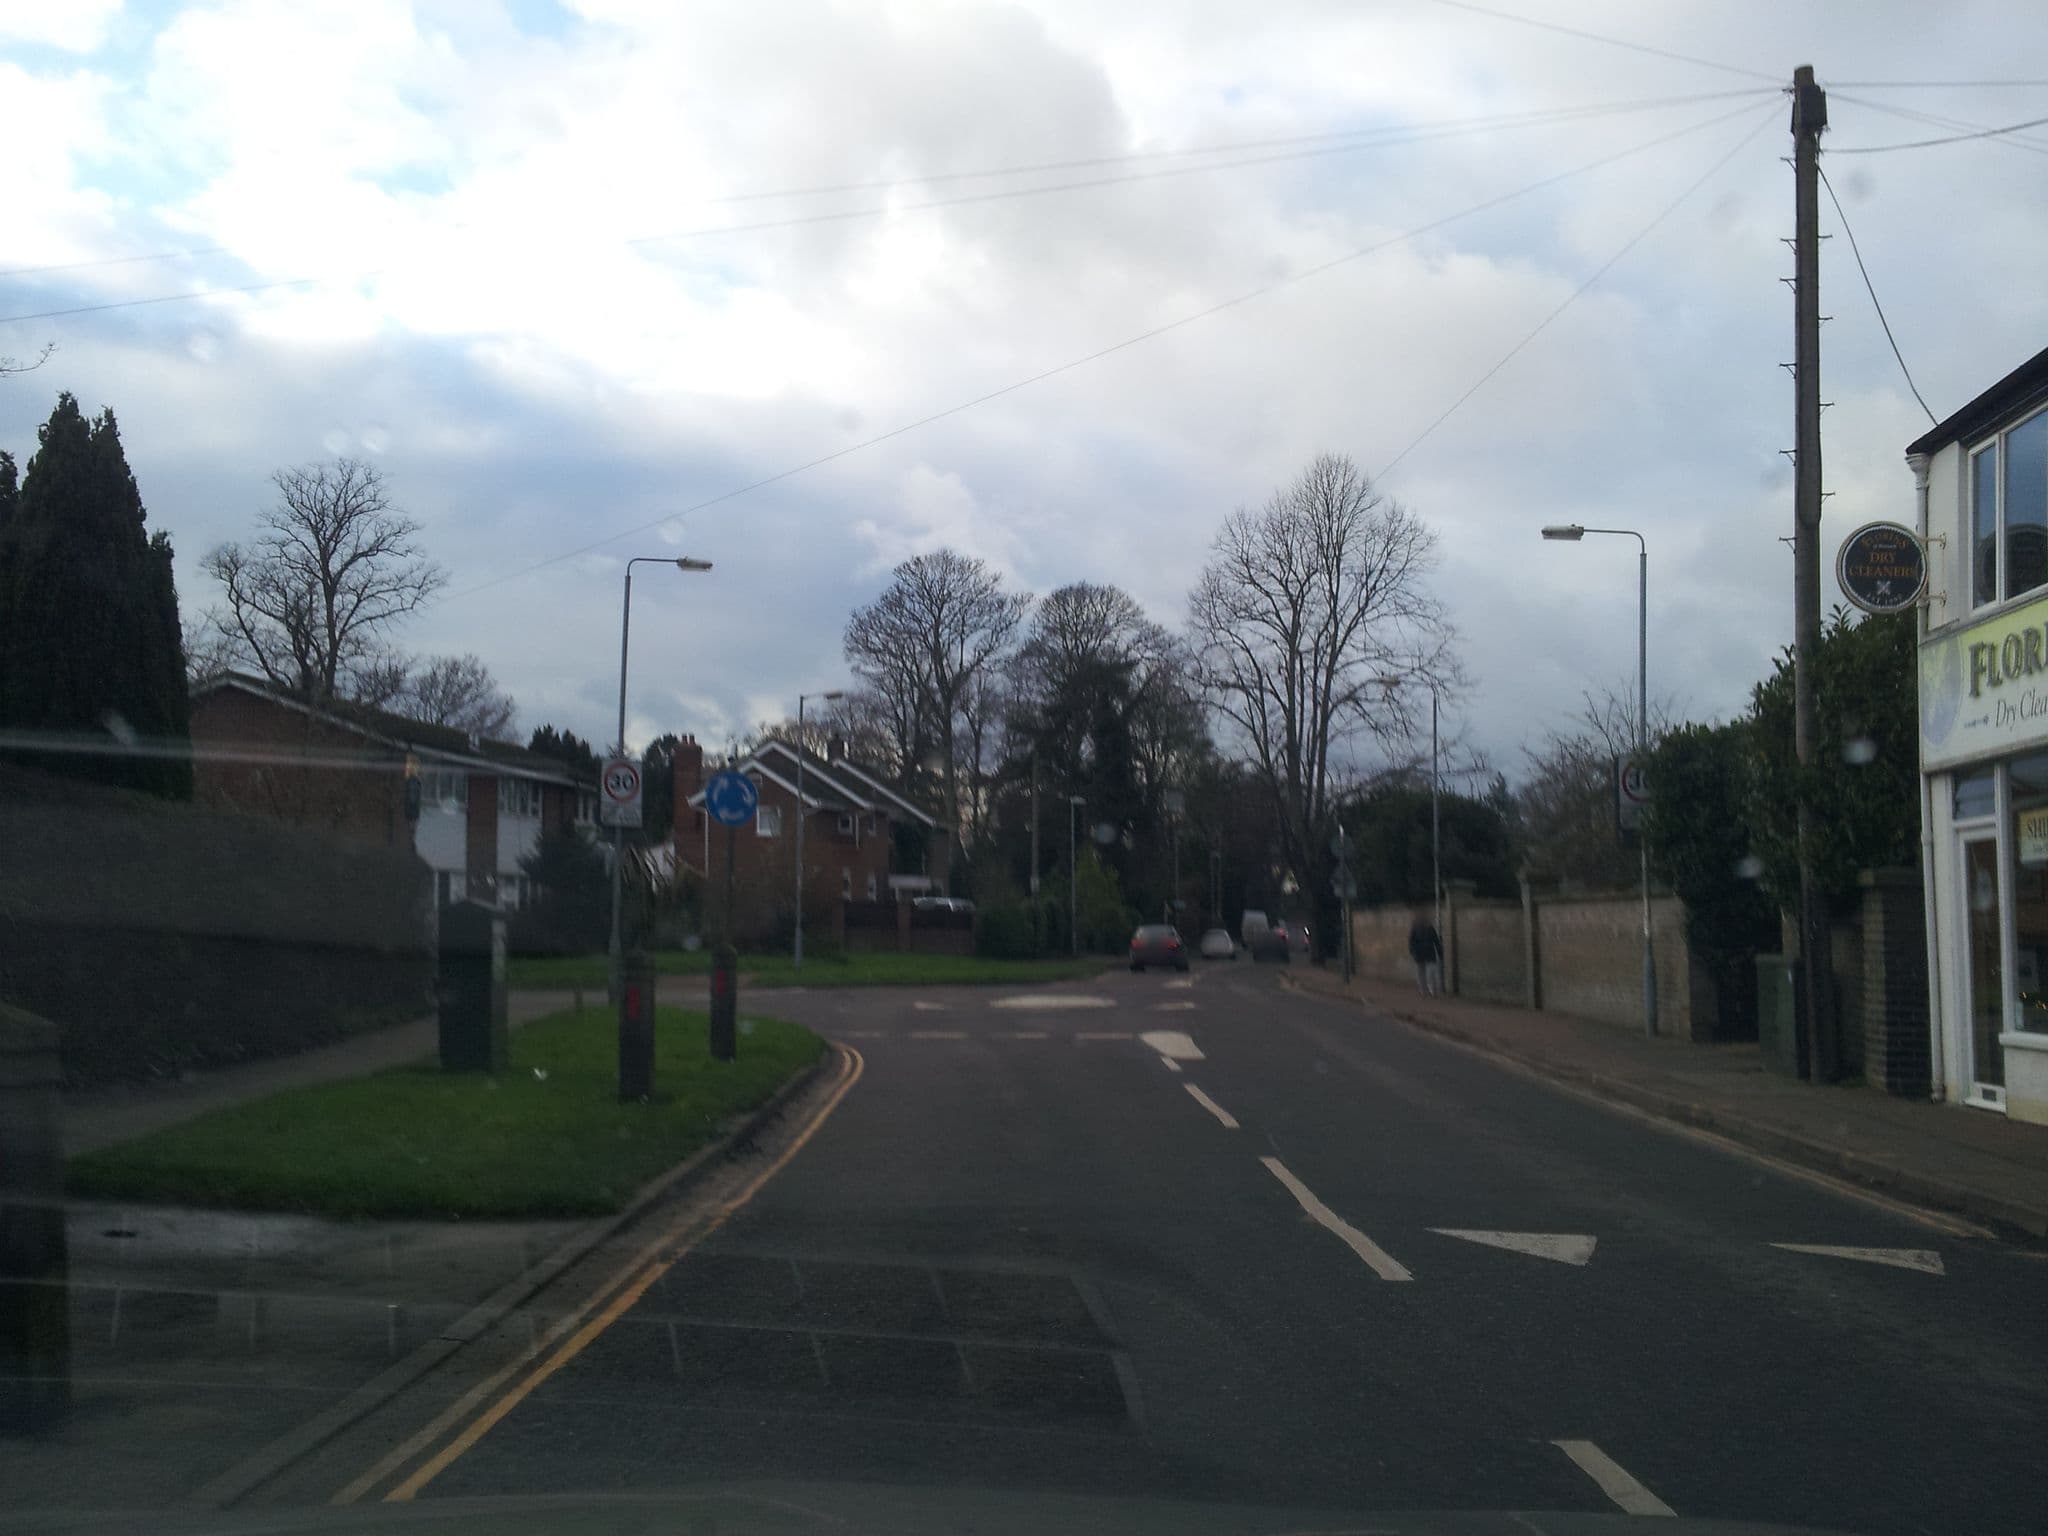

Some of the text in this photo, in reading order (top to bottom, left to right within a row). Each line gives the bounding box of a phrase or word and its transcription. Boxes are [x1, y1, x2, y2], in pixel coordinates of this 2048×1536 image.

[1870, 551, 1897, 564] DRY
[1995, 698, 2017, 733] Dry
[609, 774, 635, 792] 30
